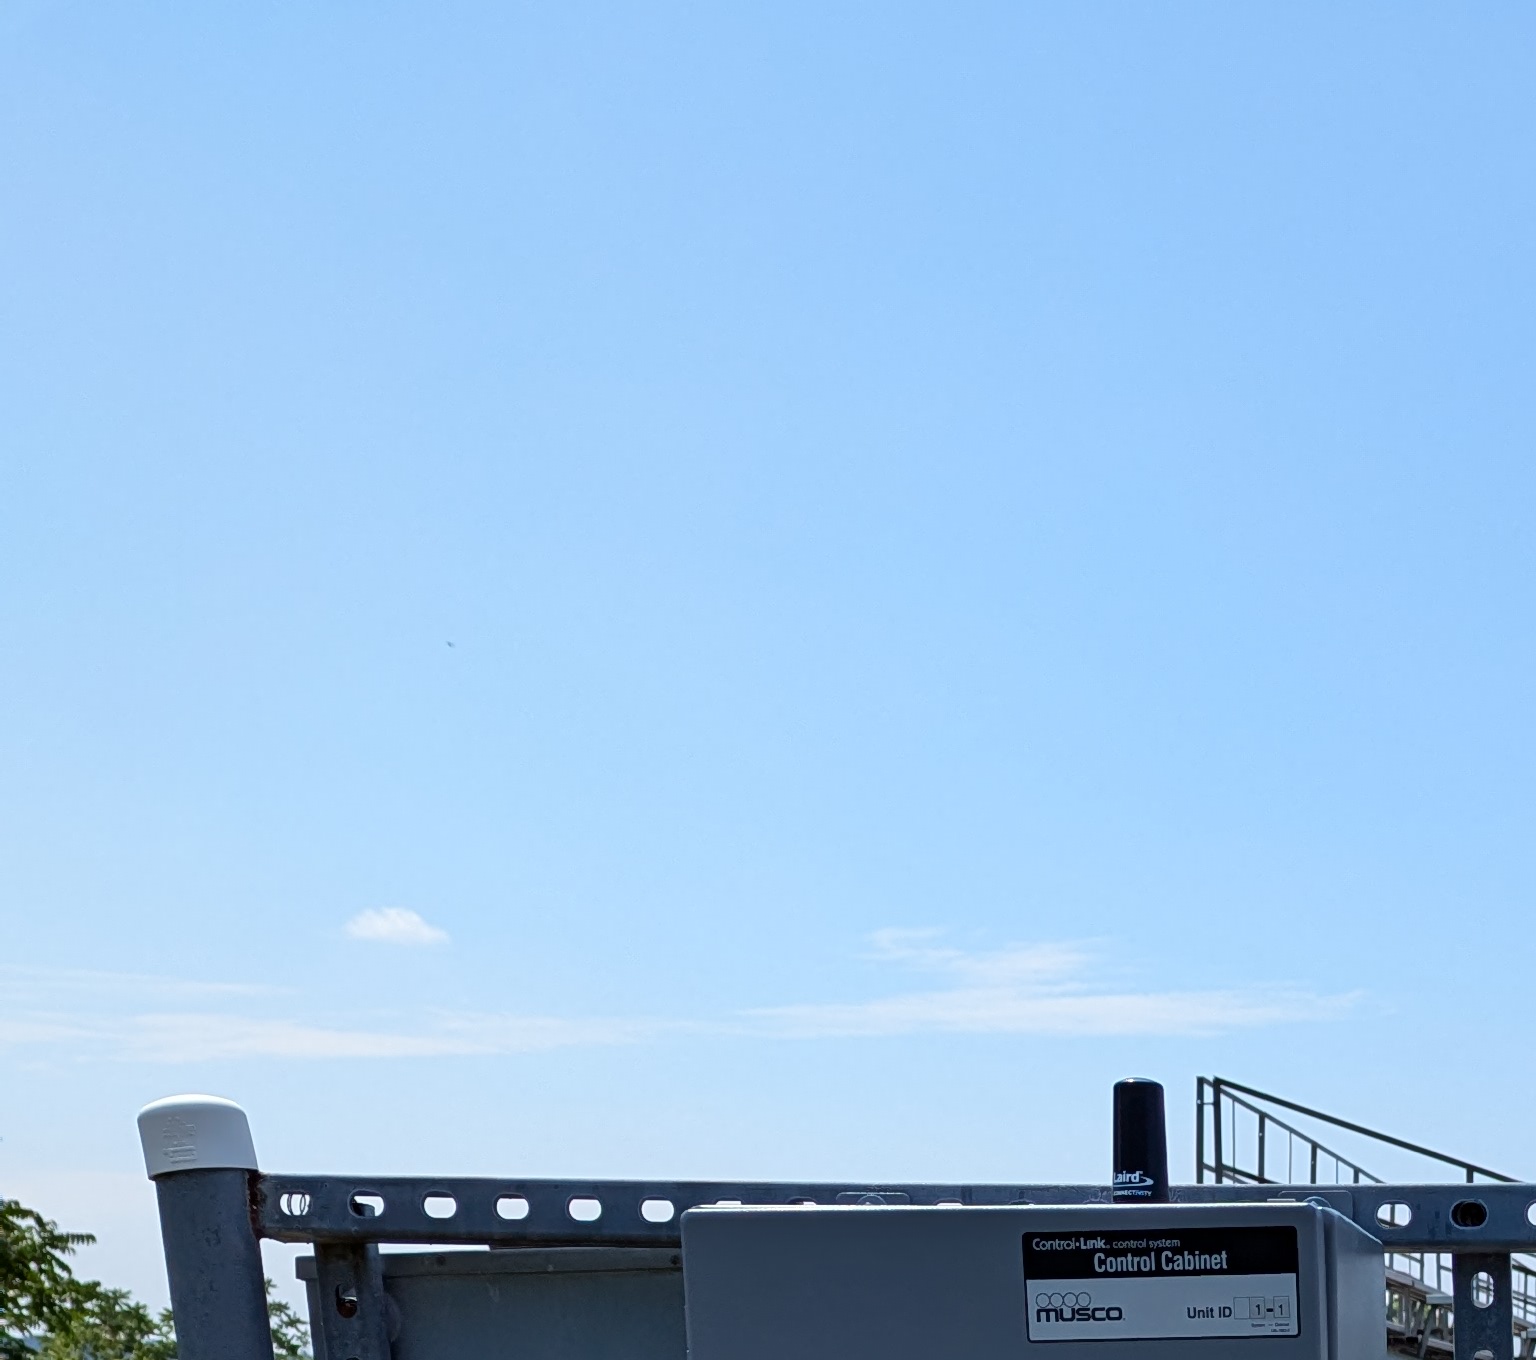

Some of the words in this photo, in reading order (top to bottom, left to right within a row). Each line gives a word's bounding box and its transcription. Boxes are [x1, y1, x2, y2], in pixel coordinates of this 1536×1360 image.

[1113, 1170, 1140, 1183] Laird
[1112, 1238, 1147, 1249] control
[1149, 1238, 1181, 1249] system
[1094, 1251, 1156, 1273] Control
[1161, 1250, 1228, 1271] Cabinet
[1187, 1306, 1215, 1319] Unit
[1218, 1306, 1233, 1319] ID
